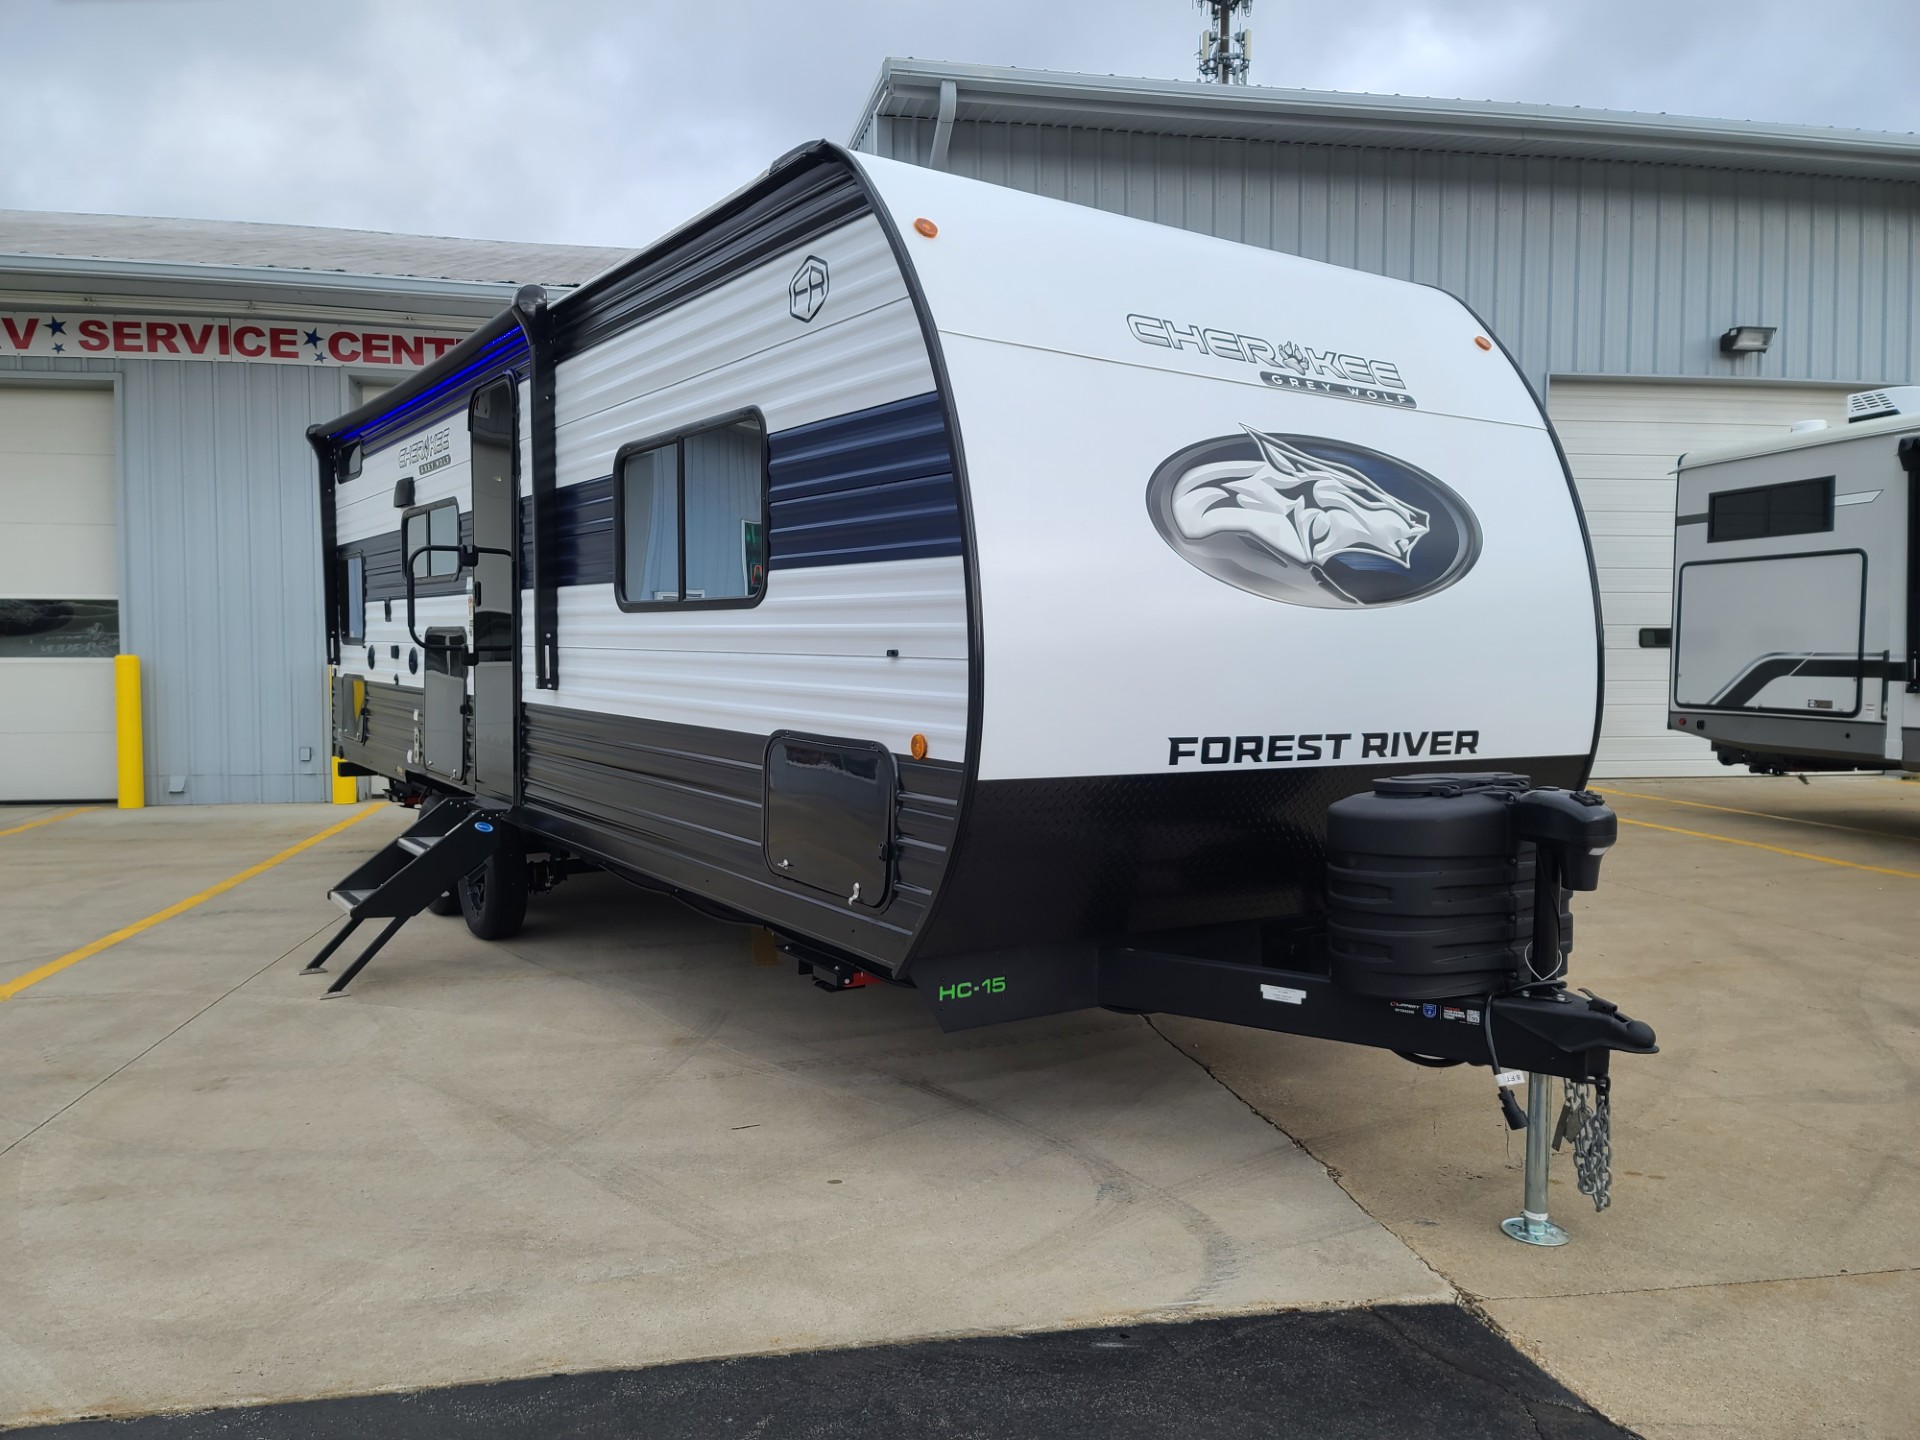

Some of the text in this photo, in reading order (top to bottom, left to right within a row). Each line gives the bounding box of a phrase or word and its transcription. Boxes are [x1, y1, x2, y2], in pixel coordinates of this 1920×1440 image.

[0, 317, 463, 366] V SERVICE CENT
[1271, 374, 1406, 404] GREY WOLF
[1168, 730, 1479, 765] FOREST RIVER
[939, 976, 1006, 1001] HC-15
